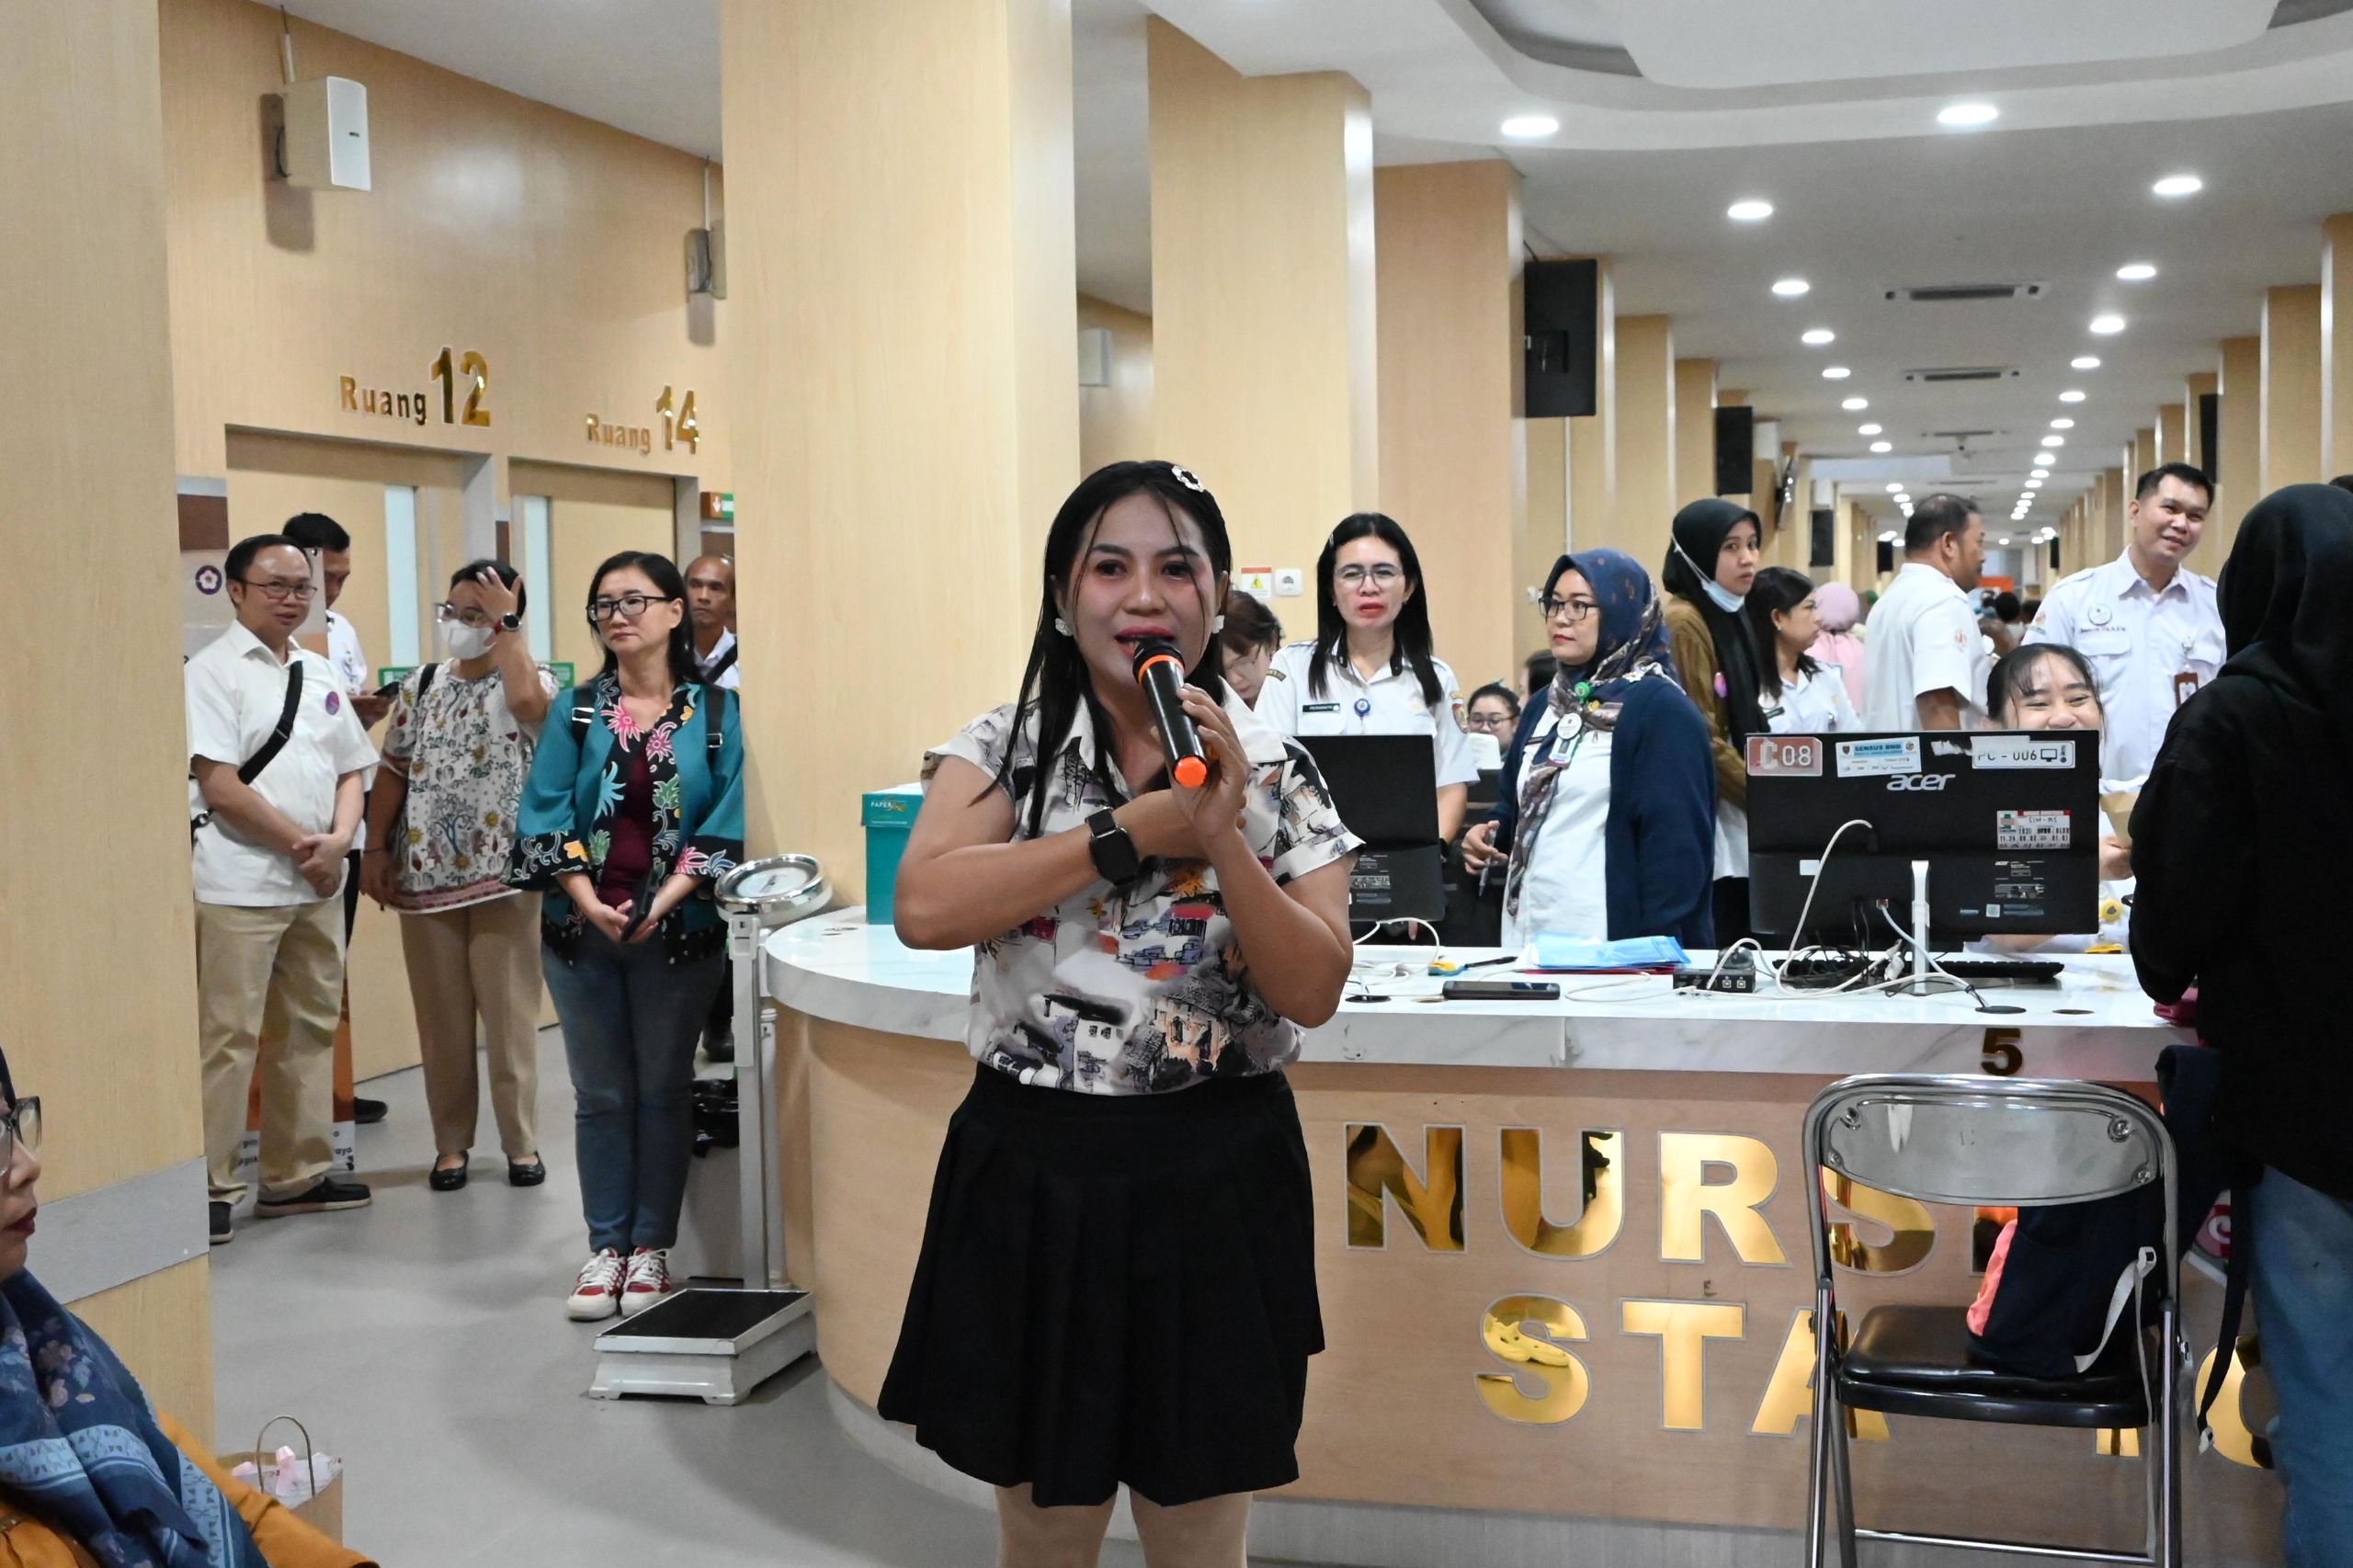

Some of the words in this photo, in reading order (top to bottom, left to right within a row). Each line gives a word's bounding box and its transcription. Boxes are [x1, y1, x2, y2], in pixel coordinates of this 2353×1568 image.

[338, 373, 427, 426] Ruang
[429, 346, 492, 427] 12
[585, 412, 652, 456] Ruang
[655, 384, 699, 455] 14
[1886, 773, 1956, 791] acer
[1981, 1027, 2025, 1077] 5
[1344, 1121, 2018, 1278] NURS
